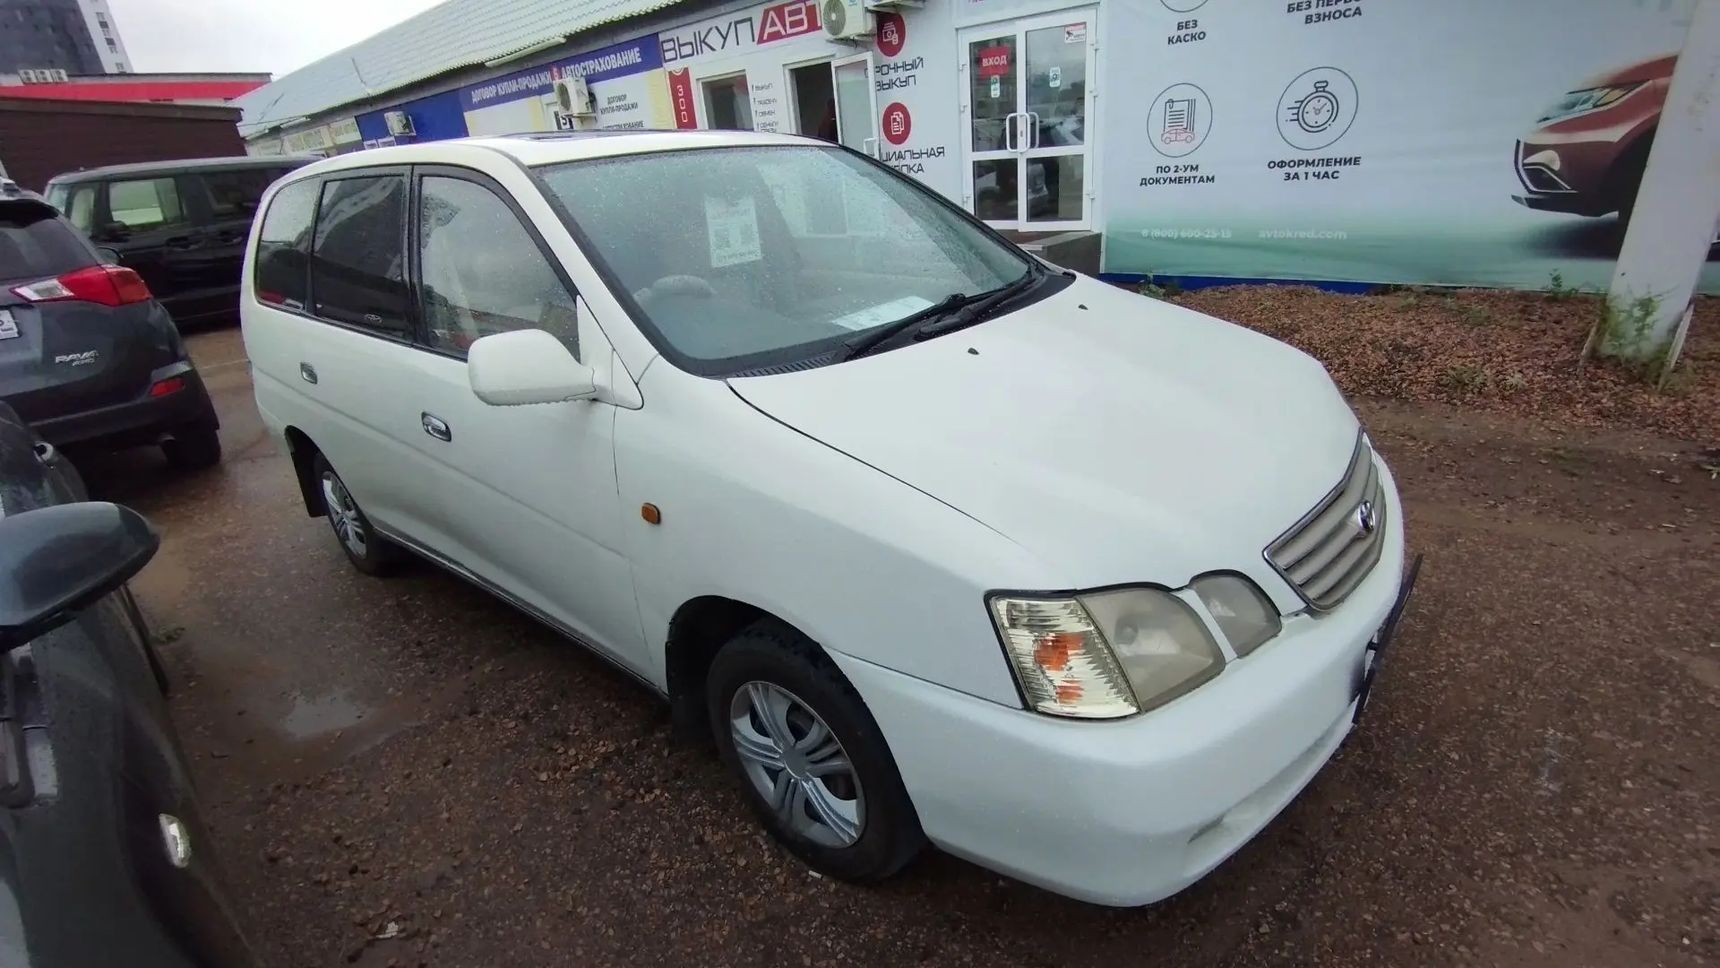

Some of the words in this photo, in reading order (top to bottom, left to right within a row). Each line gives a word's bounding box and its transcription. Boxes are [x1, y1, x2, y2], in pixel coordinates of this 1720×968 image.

[1287, 0, 1312, 13] БЕЗ
[1305, 6, 1362, 24] ВЗНОСА
[1176, 19, 1198, 31] БЕЗ
[661, 17, 755, 63] ВЫКУП
[763, 1, 822, 40] АВТ
[1167, 31, 1207, 45] КАСКО
[982, 55, 1008, 67] ВХОД
[471, 86, 498, 103] ДОГОВОР
[497, 71, 551, 97] КУПЛИ-ПРОДАЖИ
[561, 47, 643, 79] АВТОСТРАХОВАНИЕ
[875, 75, 916, 91] ВЫКУП
[882, 146, 945, 162] ЦИАЛЬНАЯ
[1156, 165, 1171, 174] ПО
[1173, 164, 1199, 174] 2-УМ
[1267, 156, 1362, 169] ОФОРМЛЕНИЕ
[1139, 175, 1215, 187] ДОКУМЕНТАМ
[1283, 172, 1301, 181] ЗА
[1303, 172, 1309, 181] 1
[1312, 170, 1340, 180] ЧАС
